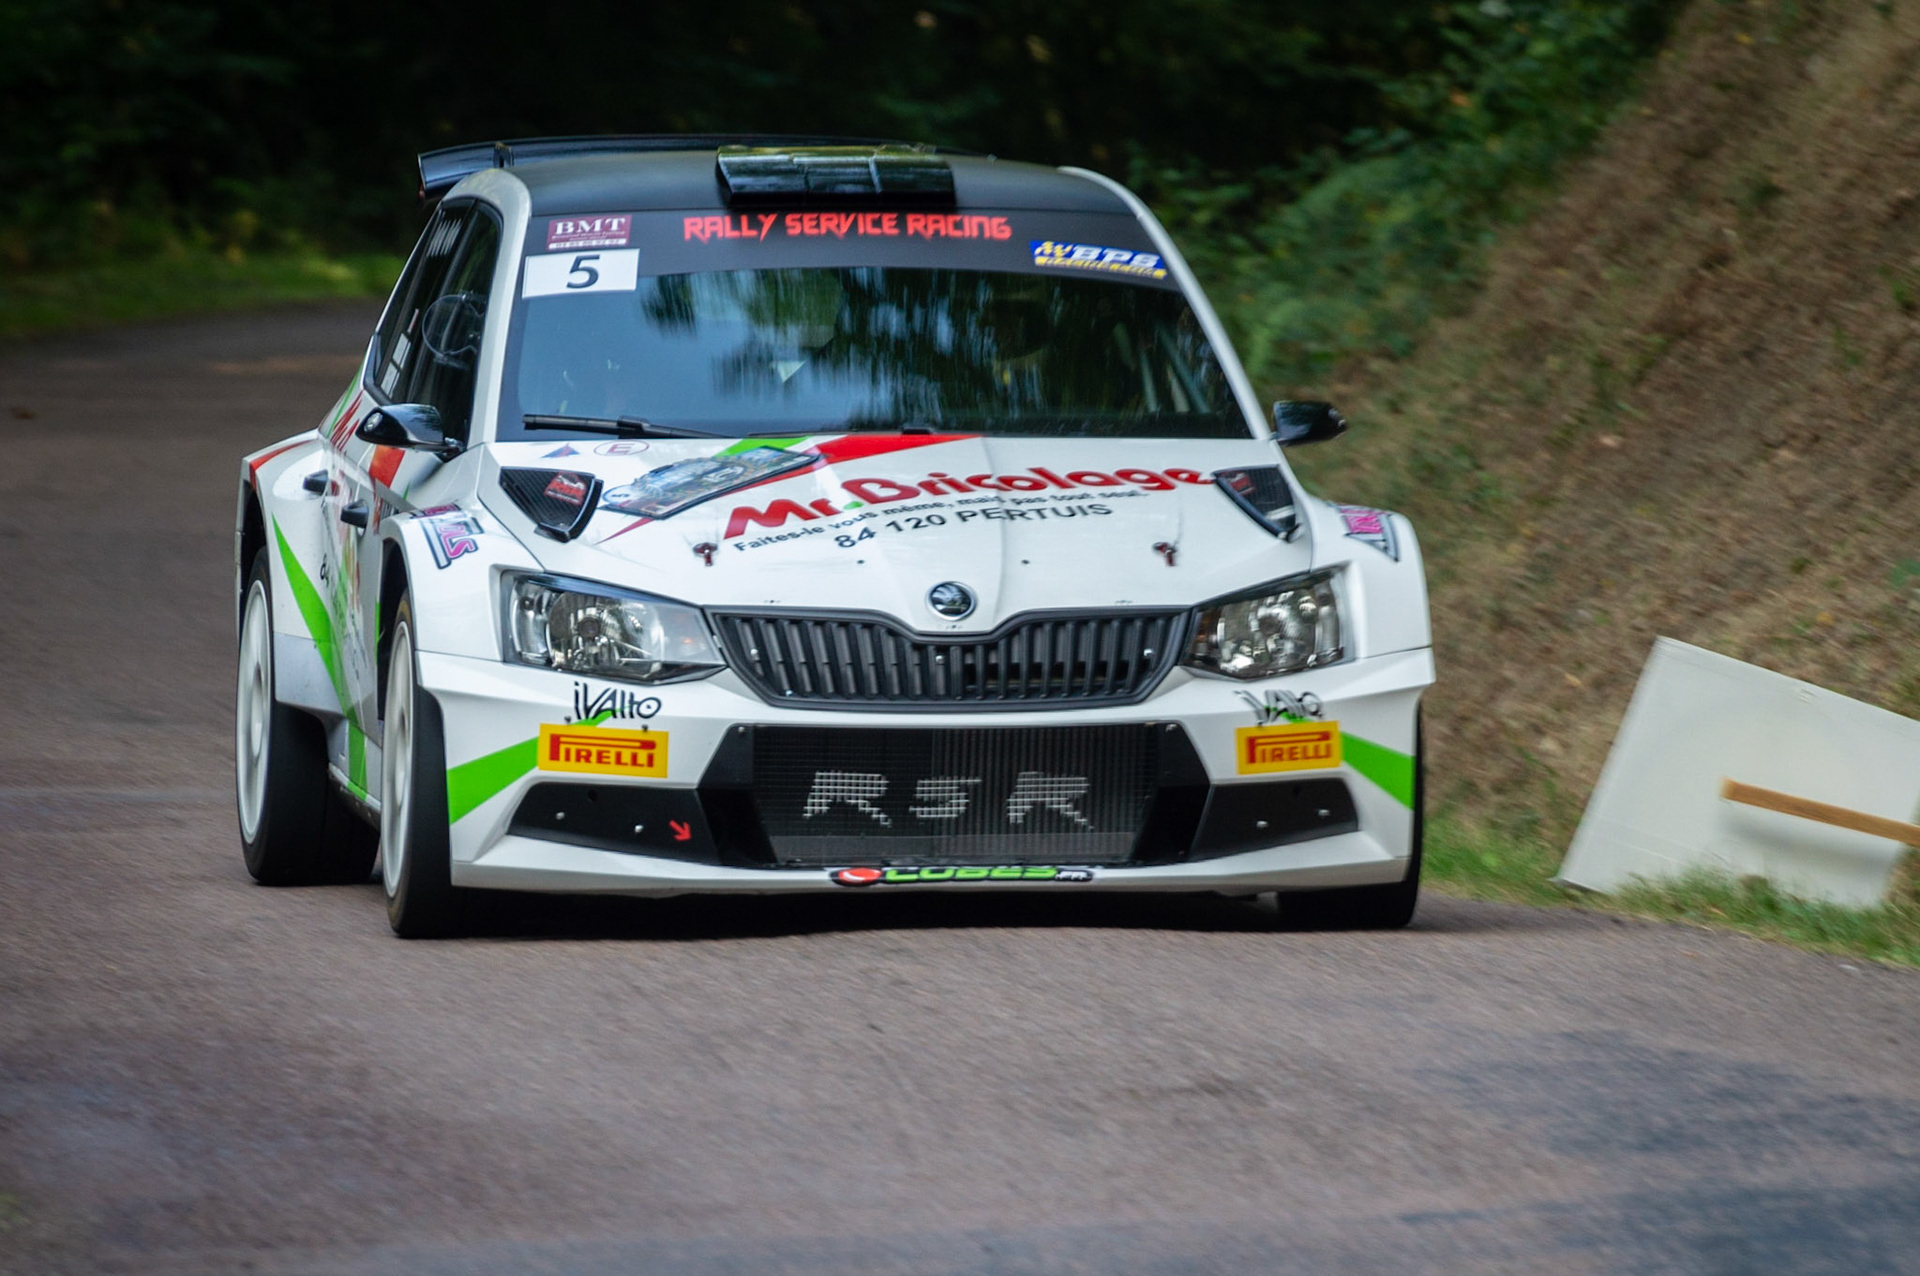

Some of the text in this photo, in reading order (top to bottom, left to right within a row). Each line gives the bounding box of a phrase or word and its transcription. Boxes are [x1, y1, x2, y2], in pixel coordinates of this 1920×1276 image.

[555, 217, 626, 235] BMT
[683, 212, 1013, 243] RALLY SERVICE RACING
[566, 254, 600, 289] 5
[733, 525, 824, 552] Faites-le
[828, 511, 879, 530] vous
[1009, 495, 1047, 507] pas
[1050, 492, 1094, 502] tout
[834, 503, 1114, 549] 84 120 PERTUIS
[548, 733, 657, 768] PIRELLI
[1246, 731, 1332, 765] PIRELLI
